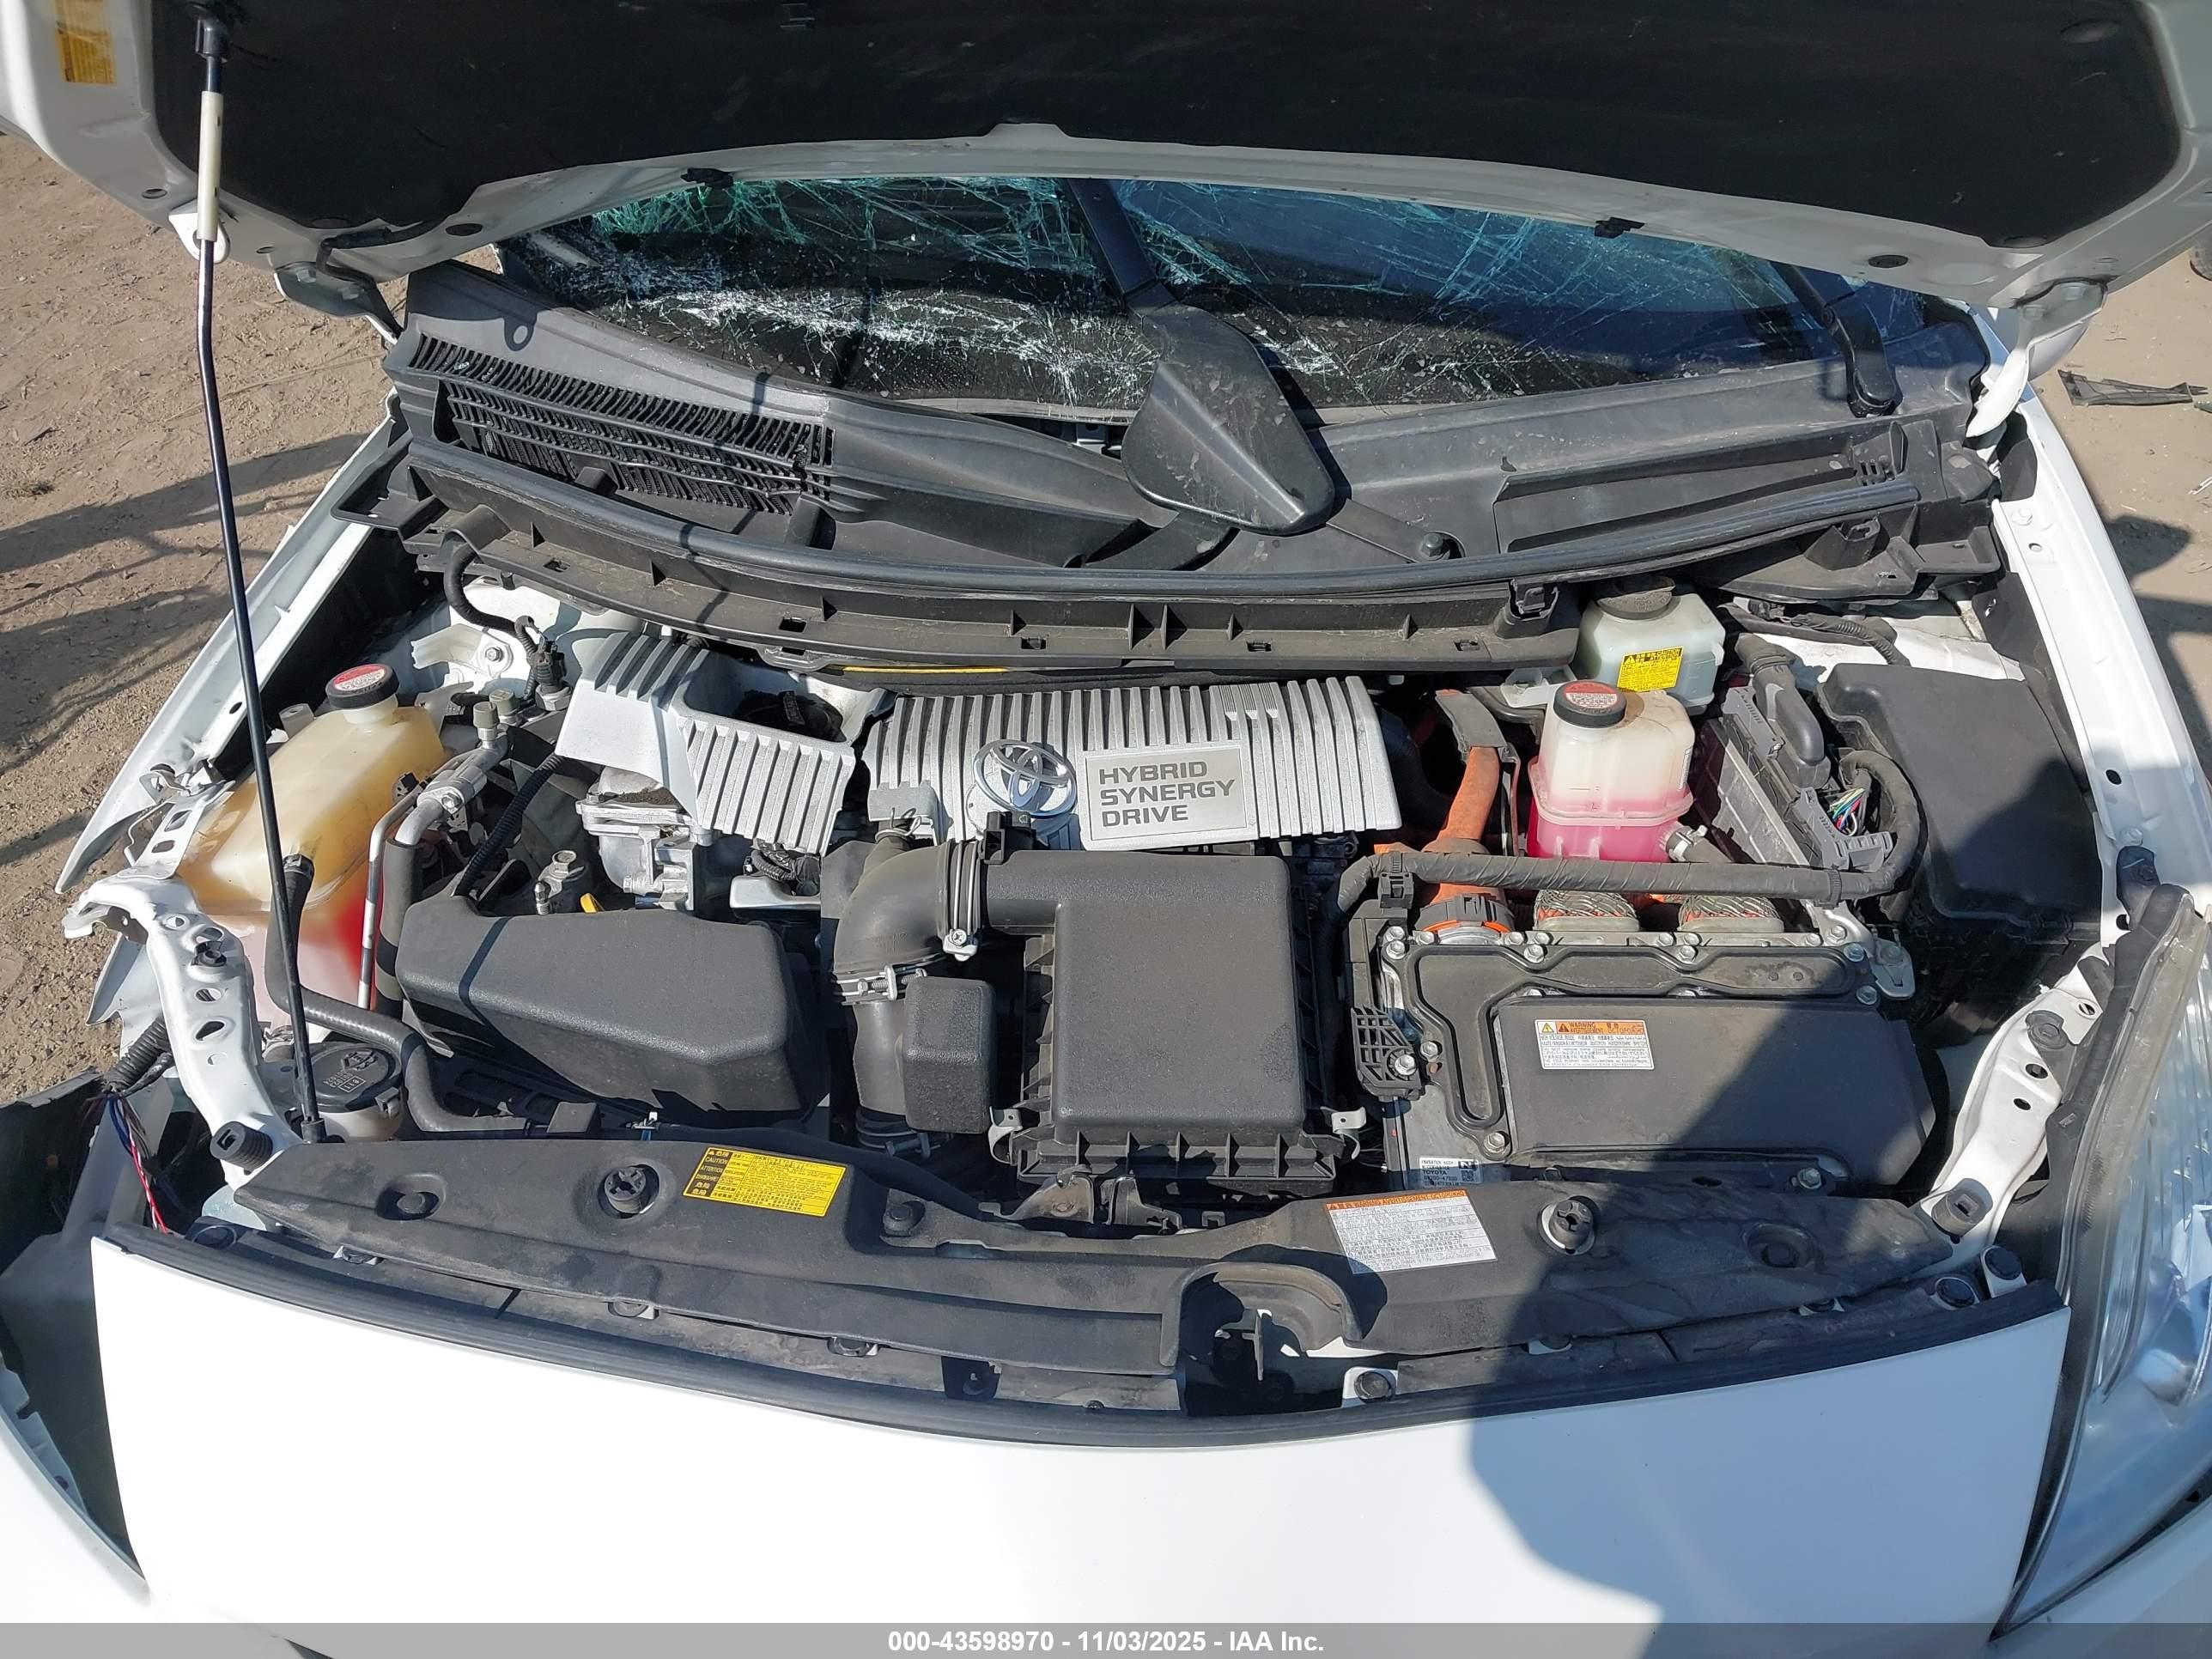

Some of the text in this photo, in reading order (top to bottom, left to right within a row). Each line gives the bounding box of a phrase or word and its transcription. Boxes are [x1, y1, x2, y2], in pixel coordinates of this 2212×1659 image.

[1099, 762, 1207, 785] HYBRID
[1100, 779, 1236, 805] SYNERGY
[1102, 805, 1188, 827] DRIVE
